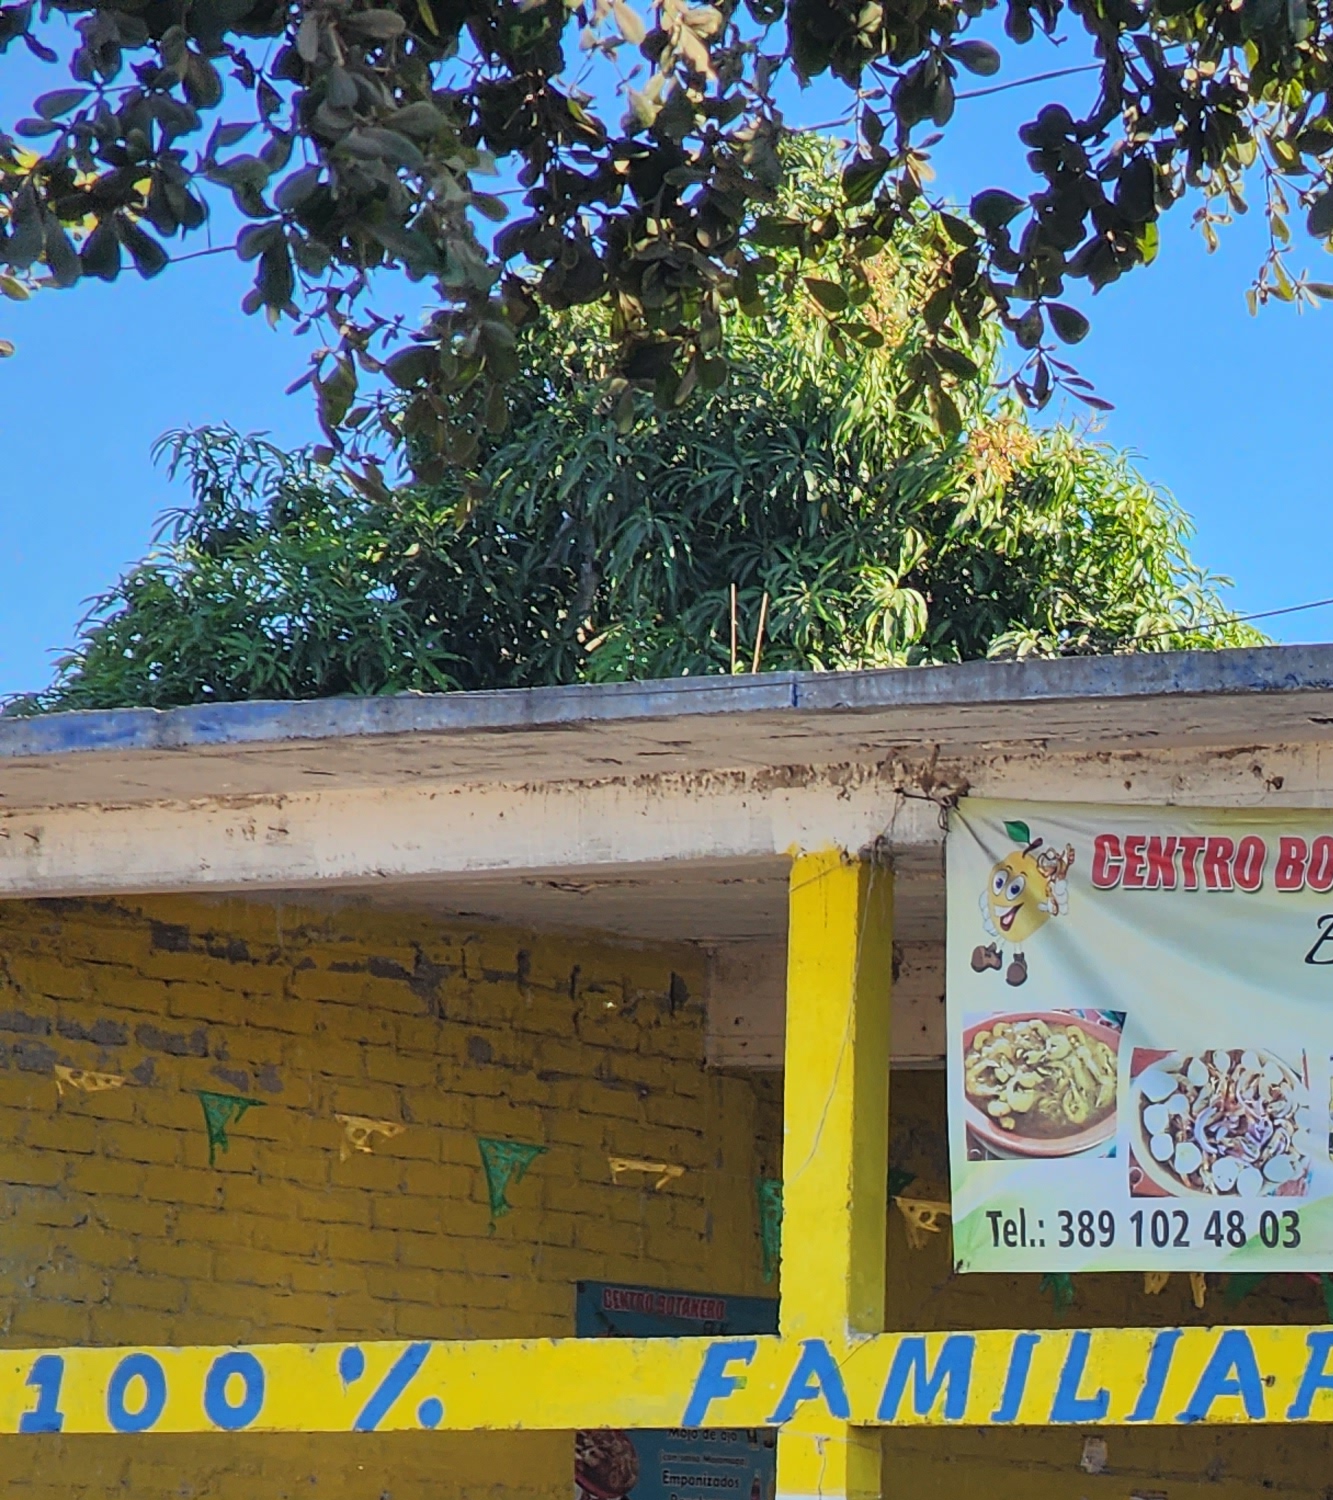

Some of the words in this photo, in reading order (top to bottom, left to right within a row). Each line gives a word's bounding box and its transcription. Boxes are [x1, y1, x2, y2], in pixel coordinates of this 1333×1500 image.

[1091, 833, 1268, 893] CENTRO
[985, 1208, 1046, 1249] Tel.:
[1058, 1210, 1116, 1248] 389
[1130, 1210, 1190, 1248] 102
[1203, 1210, 1247, 1248] 48
[1259, 1210, 1301, 1248] 03
[603, 1288, 655, 1313] CENTRO
[18, 1352, 266, 1433] 100
[703, 1428, 717, 1442] de
